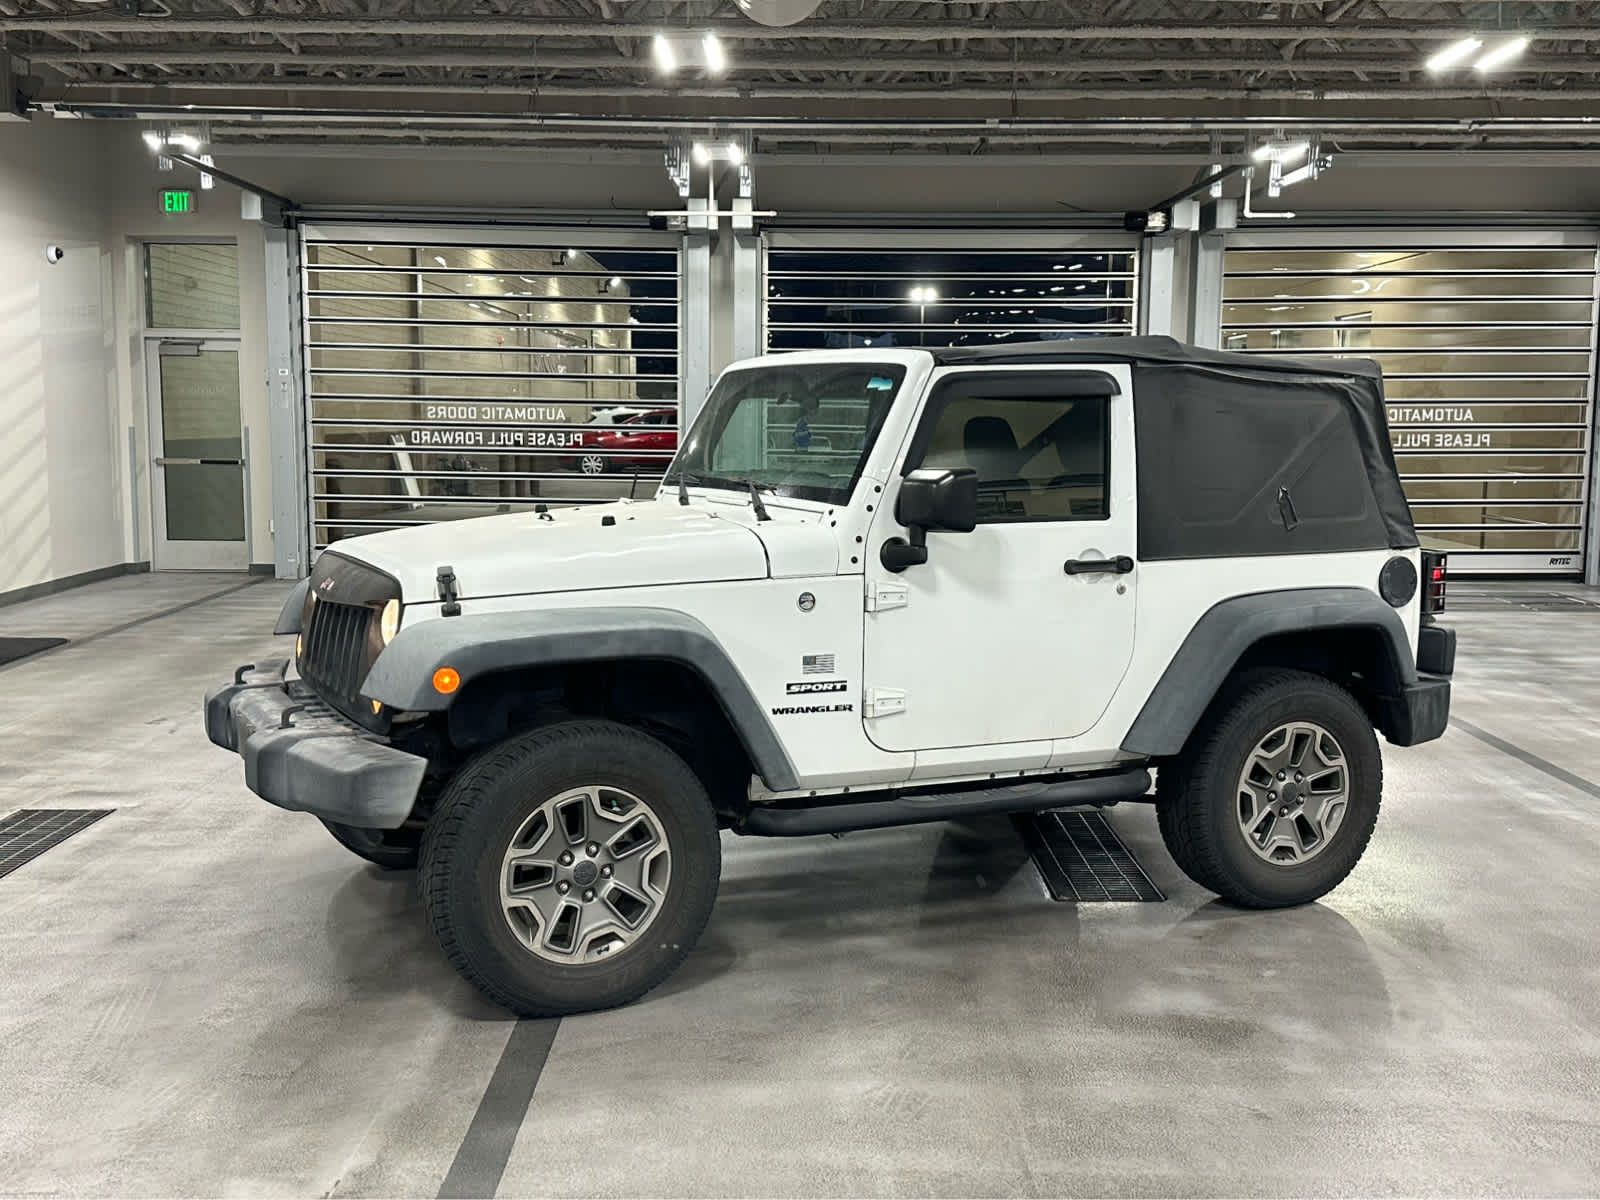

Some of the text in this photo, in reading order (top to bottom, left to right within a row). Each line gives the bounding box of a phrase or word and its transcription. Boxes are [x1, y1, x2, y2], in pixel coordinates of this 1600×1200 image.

[165, 191, 189, 211] EXIT
[789, 681, 846, 693] SPORT
[772, 704, 854, 715] WRANGLER
